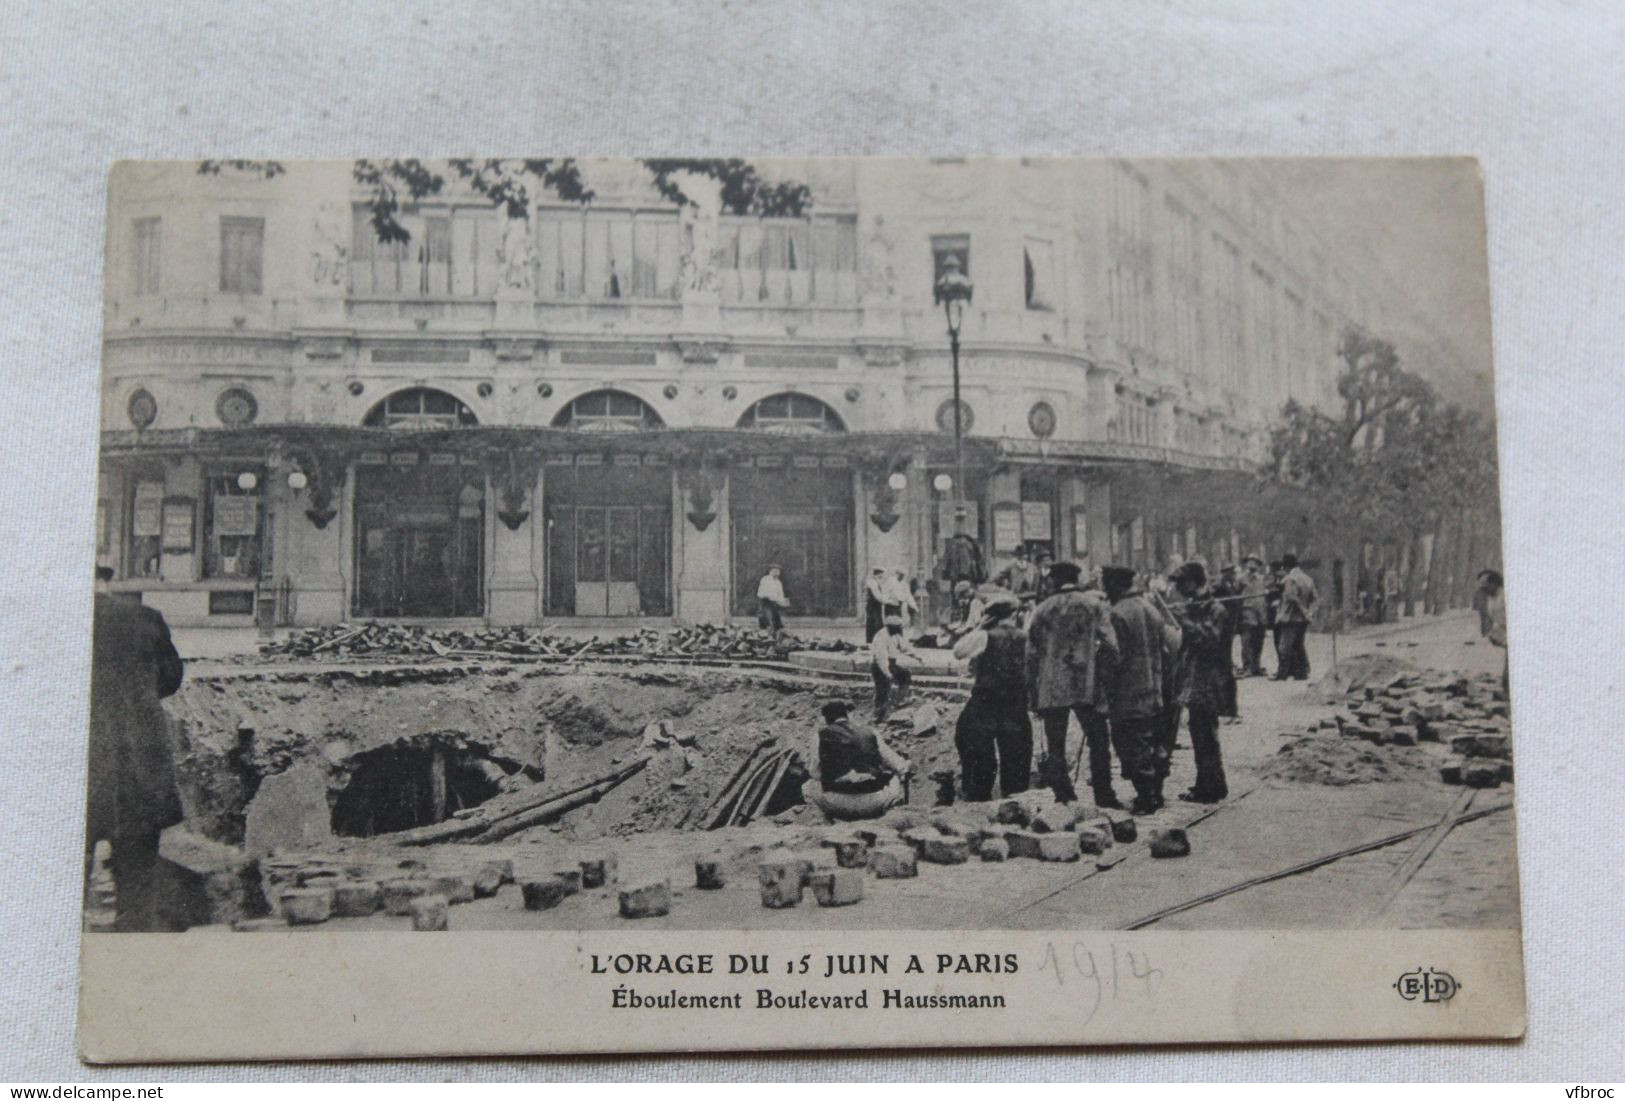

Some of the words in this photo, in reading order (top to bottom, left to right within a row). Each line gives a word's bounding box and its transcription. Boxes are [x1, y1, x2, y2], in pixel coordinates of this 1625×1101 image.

[590, 954, 714, 974] L'ORAGE
[728, 954, 769, 974] DU
[786, 954, 811, 974] 15
[823, 954, 889, 977] JUIN
[904, 954, 924, 974] A
[936, 953, 1019, 974] PARIS
[611, 984, 743, 1009] Éboulement
[756, 988, 869, 1009] Boulevard
[882, 988, 1007, 1009] Haussmann
